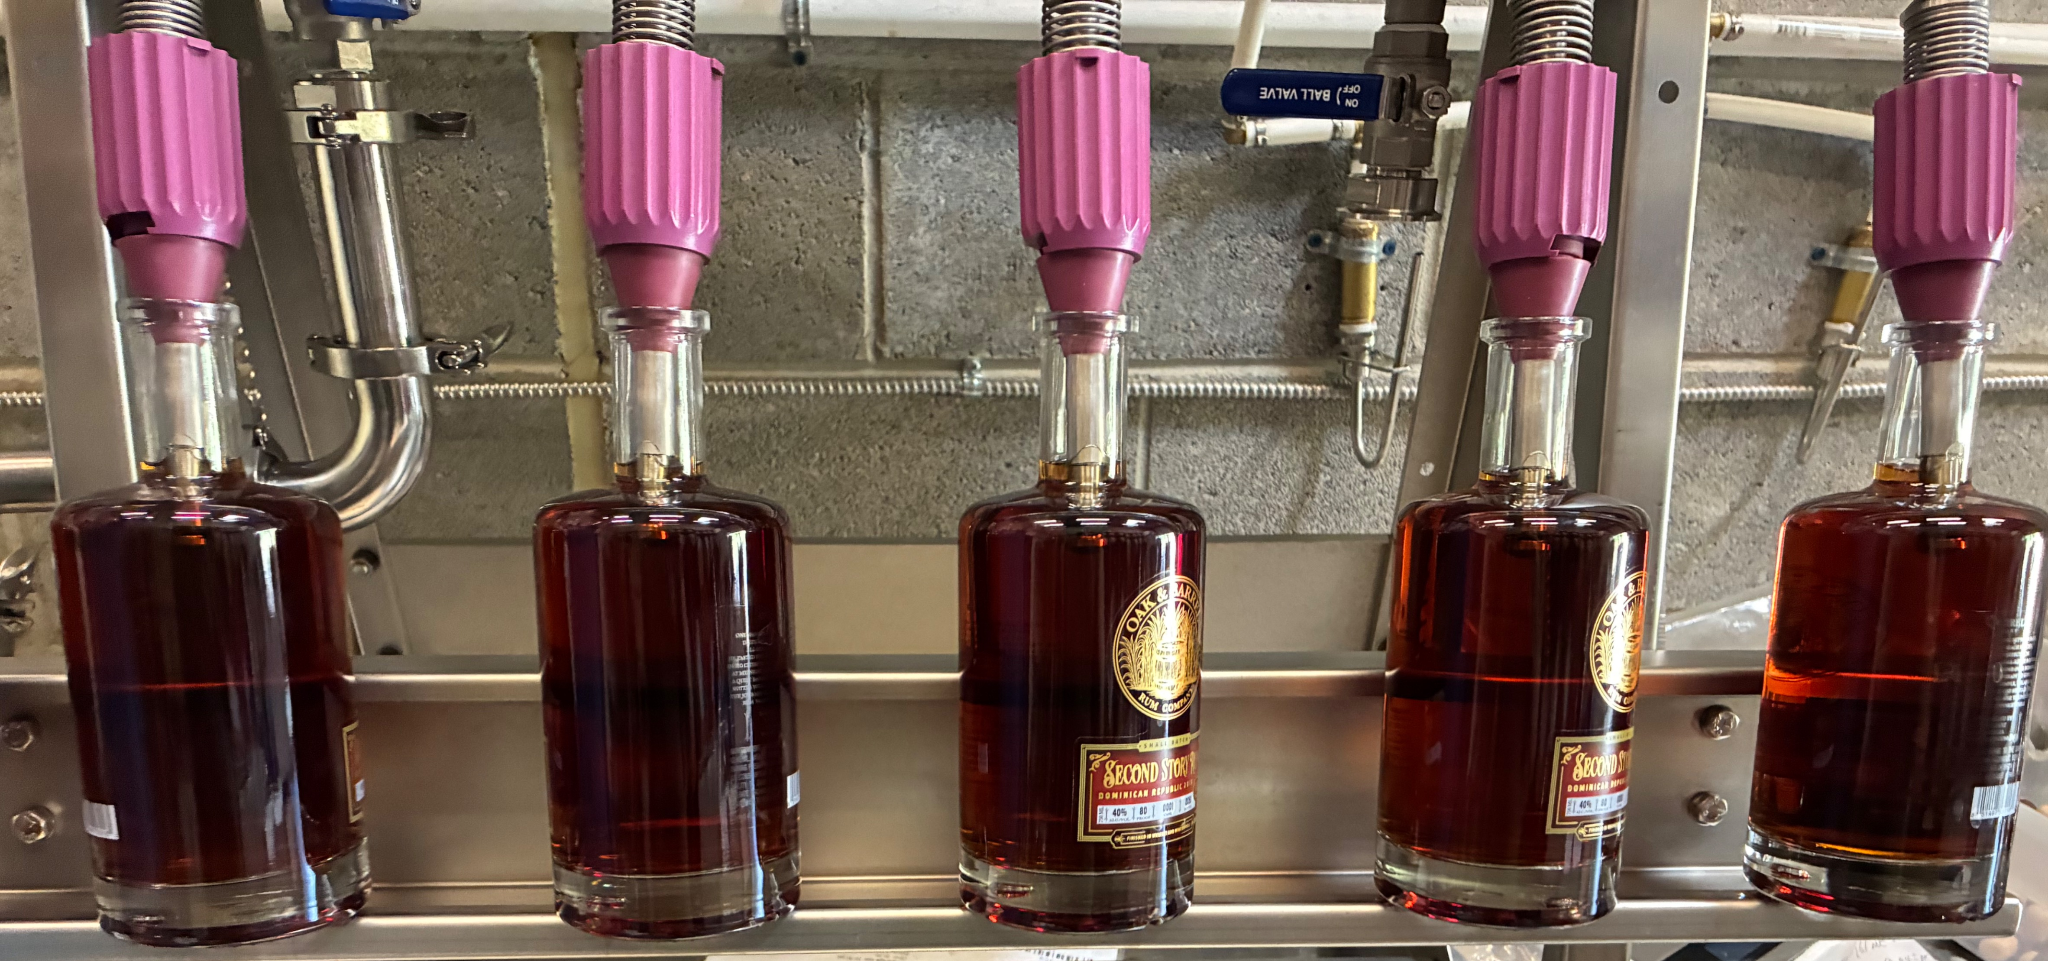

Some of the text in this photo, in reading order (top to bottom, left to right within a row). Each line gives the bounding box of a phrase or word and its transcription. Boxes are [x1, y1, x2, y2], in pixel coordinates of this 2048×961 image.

[1259, 86, 1331, 101] BALL VALVE
[1342, 84, 1361, 94] OFF
[1344, 98, 1359, 108] ON
[1126, 594, 1157, 633] OAK
[1156, 586, 1169, 602] &
[1138, 688, 1194, 713] RUM COMPANY
[1103, 760, 1159, 788] SECOND
[1161, 754, 1190, 781] STORY
[1573, 752, 1618, 781] SECOND
[1098, 789, 1148, 800] DOMINICAN
[1151, 783, 1183, 797] REPUBLIC
[1567, 781, 1609, 792] DOMINICAN
[1112, 808, 1128, 817] 40%
[1139, 806, 1148, 815] 80
[1579, 800, 1592, 809] 40%
